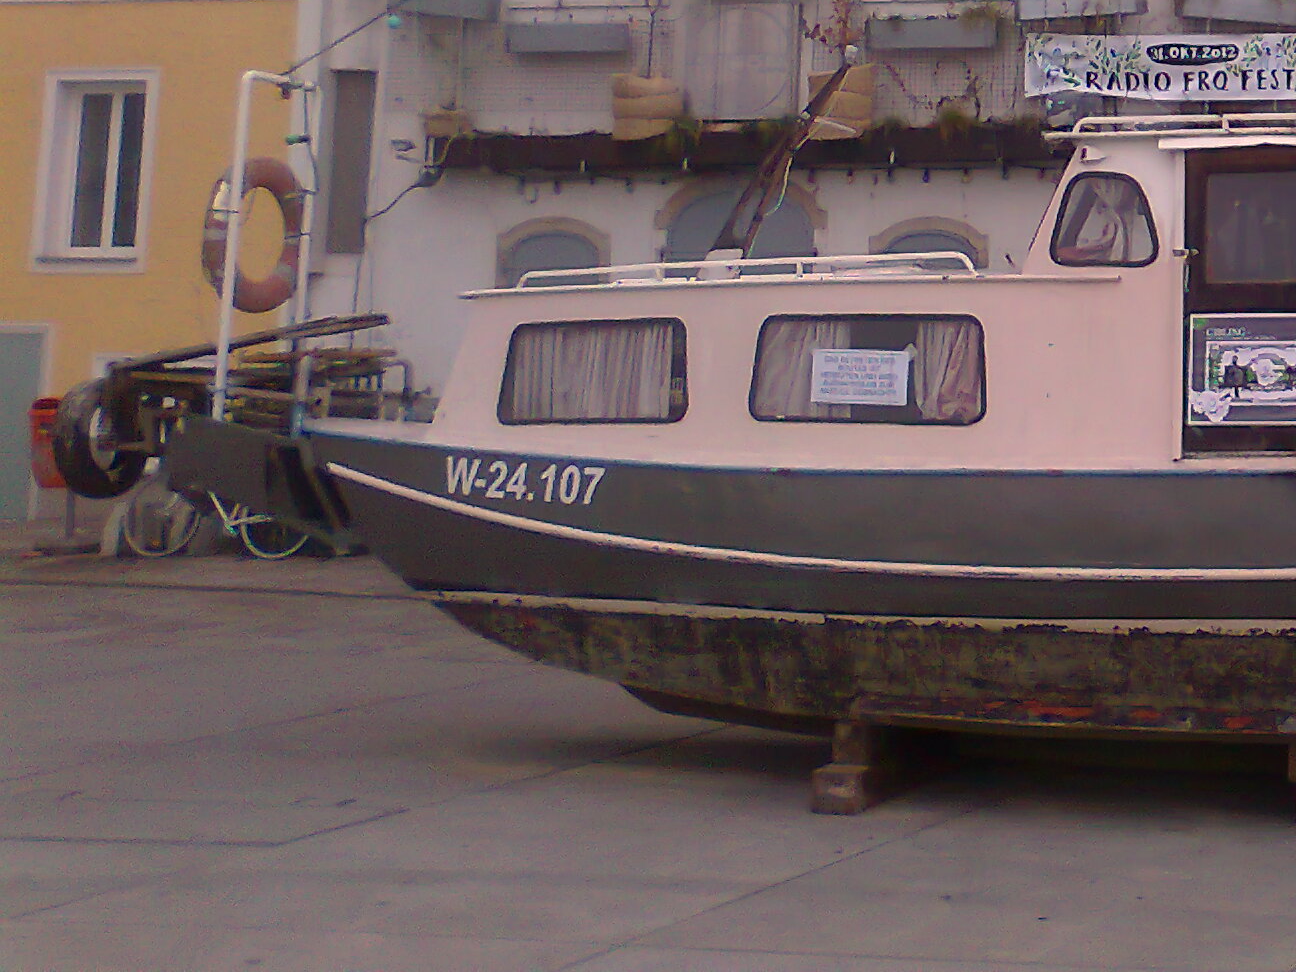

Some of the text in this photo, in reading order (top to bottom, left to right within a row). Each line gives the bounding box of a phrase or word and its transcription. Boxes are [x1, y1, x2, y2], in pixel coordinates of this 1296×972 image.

[1085, 70, 1172, 92] RADIO
[1241, 68, 1296, 91] FEST
[446, 455, 606, 505] W-24.107
